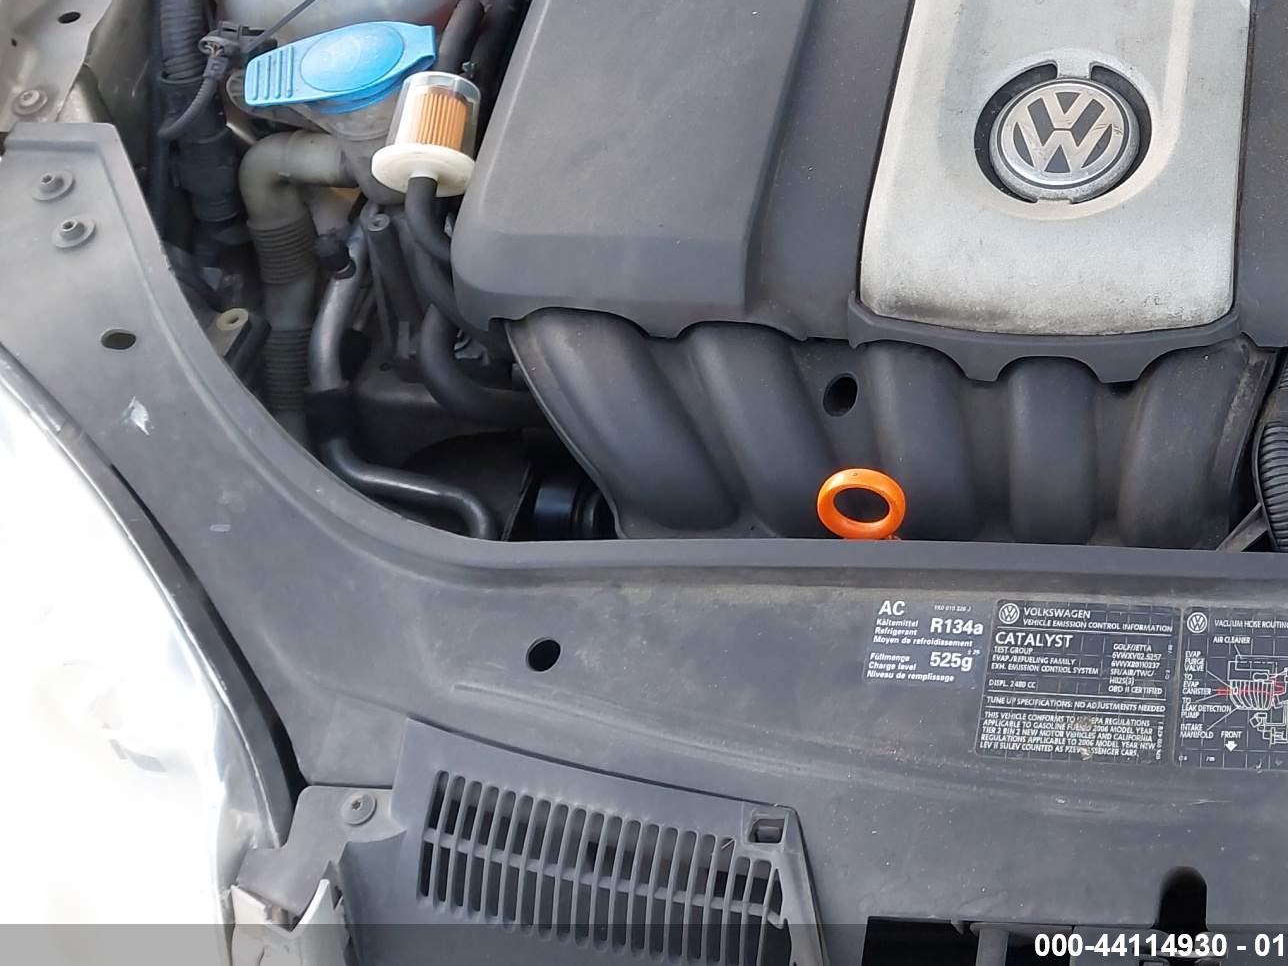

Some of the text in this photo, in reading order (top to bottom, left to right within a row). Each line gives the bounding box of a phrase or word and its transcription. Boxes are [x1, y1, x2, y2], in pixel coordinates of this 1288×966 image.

[878, 600, 905, 615] AC
[1024, 607, 1091, 619] VOLKSWAGEN
[876, 617, 984, 635] Kältemittel R134a
[1023, 618, 1173, 632] VEHICLE EMISSION CONTROL INFORMATION
[1214, 619, 1243, 628] VACUUM
[1243, 619, 1261, 628] HOSE
[875, 626, 918, 636] Refrigerant
[873, 635, 973, 647] Moyen de refroidissement
[995, 632, 1074, 648] CATALYST
[1009, 646, 1034, 655] GROUP
[1113, 643, 1152, 652] GOLF/JETTA
[868, 661, 916, 671] Charge level
[870, 651, 973, 671] Füllmenge 525g
[1050, 657, 1076, 665] FAMILY
[1007, 663, 1039, 672] EMISSION
[1041, 665, 1071, 673] CONTROL
[1072, 666, 1099, 675] SYSTEM
[867, 670, 955, 682] Niveau de remplissage
[989, 679, 1008, 687] DISPL.
[1027, 681, 1036, 689] CC
[1108, 685, 1163, 694] OBD CERTIFIED
[1182, 687, 1212, 695] CANISTER
[987, 696, 1005, 704] TUNE
[1006, 697, 1016, 705] UP
[1016, 698, 1073, 708] SPECIFICATIONS:
[1086, 701, 1137, 711] ADJUSTMENTS
[1138, 704, 1166, 712] NEEDED
[1198, 704, 1232, 712] DETECTION
[984, 711, 999, 719] THIS
[1001, 712, 1027, 720] VEHICLE
[1028, 713, 1064, 722] CONFORMS
[1066, 715, 1075, 723] TO
[1104, 717, 1150, 727] REGULATIONS
[983, 719, 1021, 728] APPLICABLE
[1033, 722, 1066, 731] GASOLINE
[1110, 726, 1133, 734] MODEL
[1135, 727, 1153, 735] YEAR
[982, 726, 1153, 742] TIER MOTOR VEHICLES AND CALIFORNIA
[979, 741, 1054, 752] LEV SULEV COUNTED
[980, 733, 1156, 750] REGULATIONS APPLICABLE MODEL YEAR NEW
